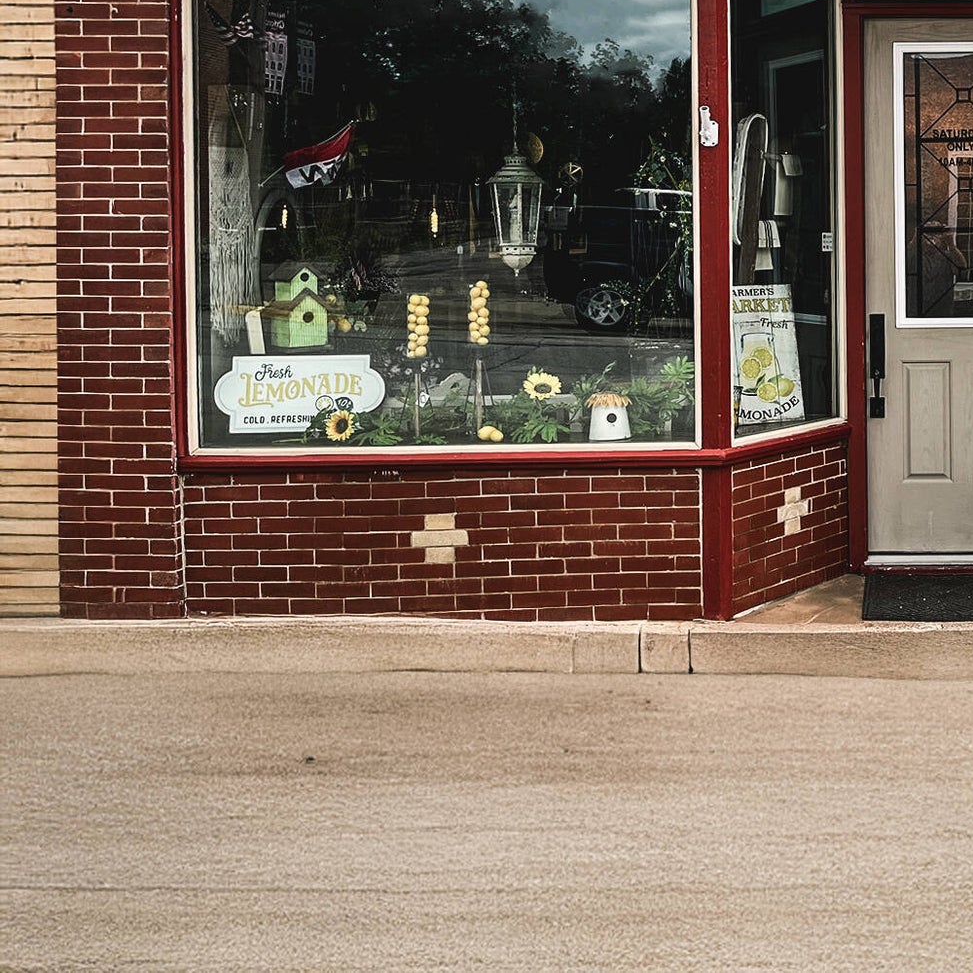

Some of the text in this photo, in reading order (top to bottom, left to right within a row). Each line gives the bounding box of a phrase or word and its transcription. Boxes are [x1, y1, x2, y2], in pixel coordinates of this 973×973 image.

[759, 317, 789, 330] Fresh
[254, 363, 294, 382] Fresh
[238, 371, 363, 408] LEMONADE
[738, 394, 800, 420] MONADE
